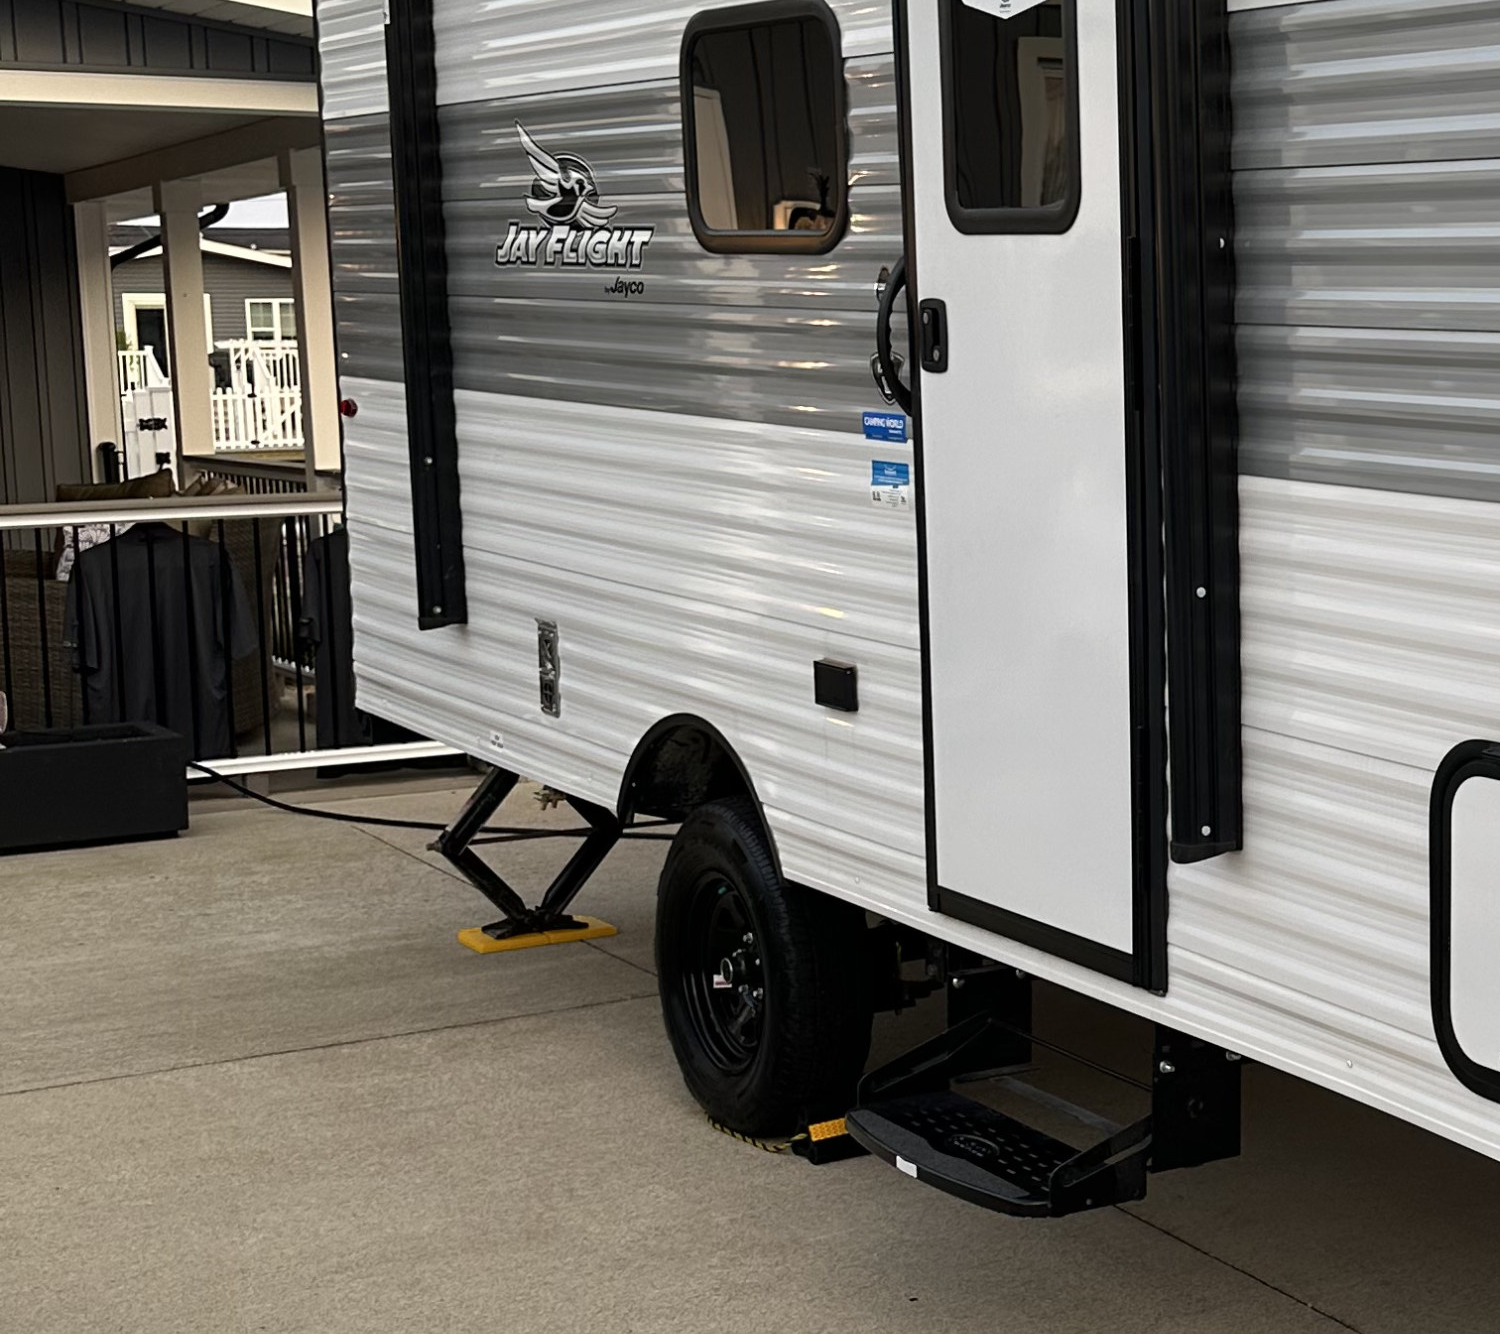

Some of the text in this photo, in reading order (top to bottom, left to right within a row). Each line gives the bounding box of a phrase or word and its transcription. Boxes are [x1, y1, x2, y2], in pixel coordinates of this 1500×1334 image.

[495, 220, 655, 270] JAY FLIGHT
[610, 277, 645, 298] Jayco
